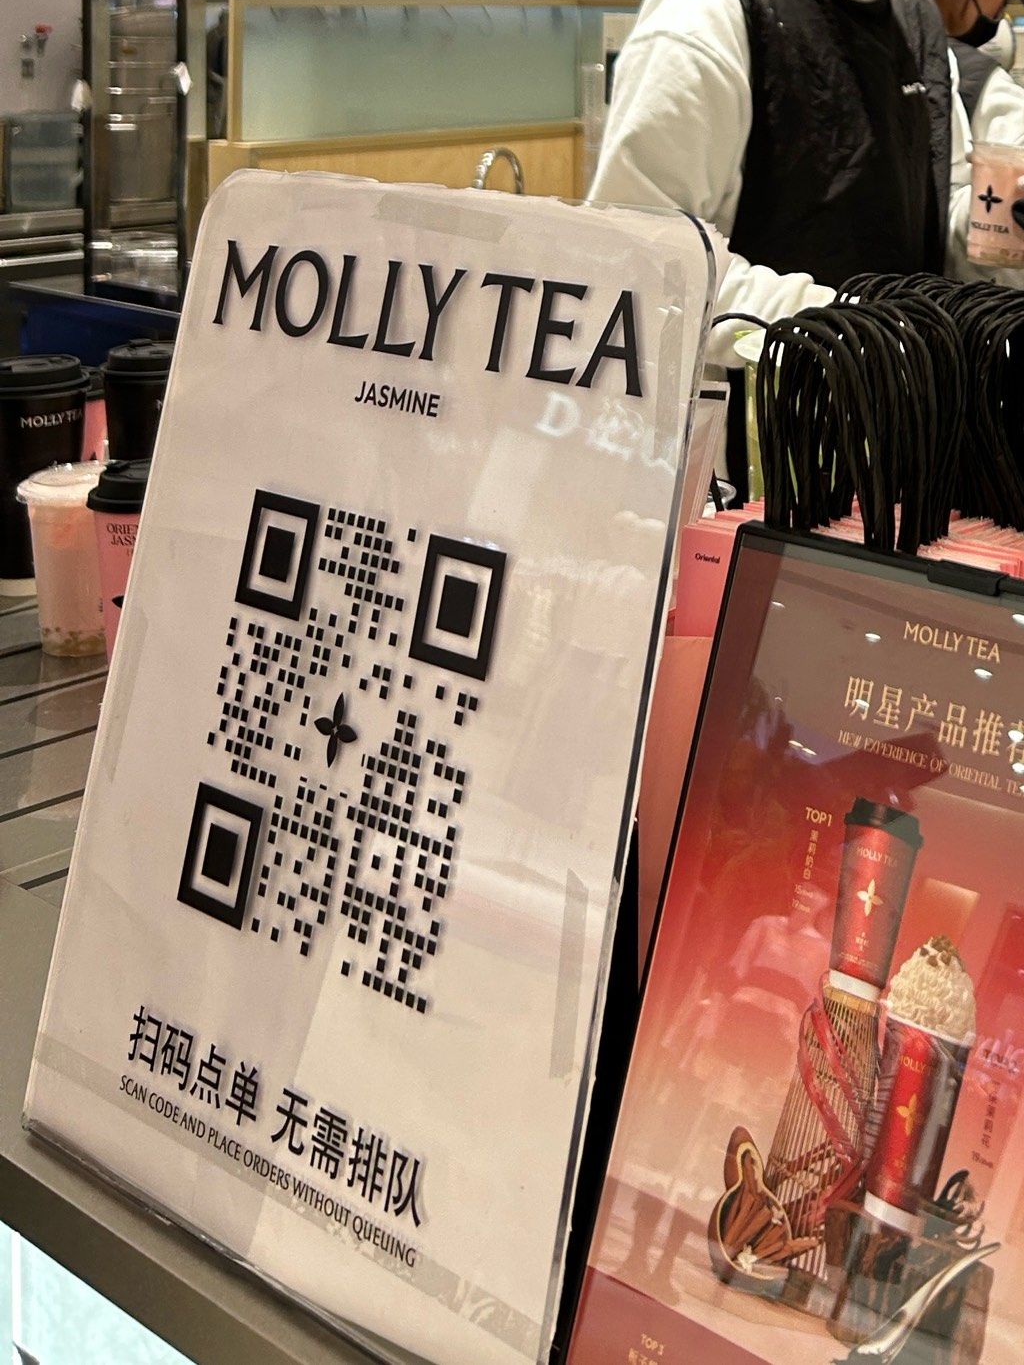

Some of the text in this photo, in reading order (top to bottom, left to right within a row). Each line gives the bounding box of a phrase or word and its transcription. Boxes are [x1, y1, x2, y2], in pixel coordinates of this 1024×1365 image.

[212, 239, 644, 398] MOLLY TEA
[354, 381, 440, 418] JASMINE
[20, 413, 65, 429] MOLLY
[695, 552, 721, 564] Oriental
[903, 621, 1000, 663] MOLLY TEA
[837, 730, 862, 748] NEW
[864, 737, 927, 769] EXPERIENCE
[930, 752, 949, 773] OF
[949, 762, 1002, 790] ORIENTAL
[805, 806, 832, 827] TOP1
[128, 1005, 424, 1228] 扫码点单 无需排队
[119, 1074, 417, 1269] SCAN CODE AND PLACE ORDERS WITHOUT QUEUING
